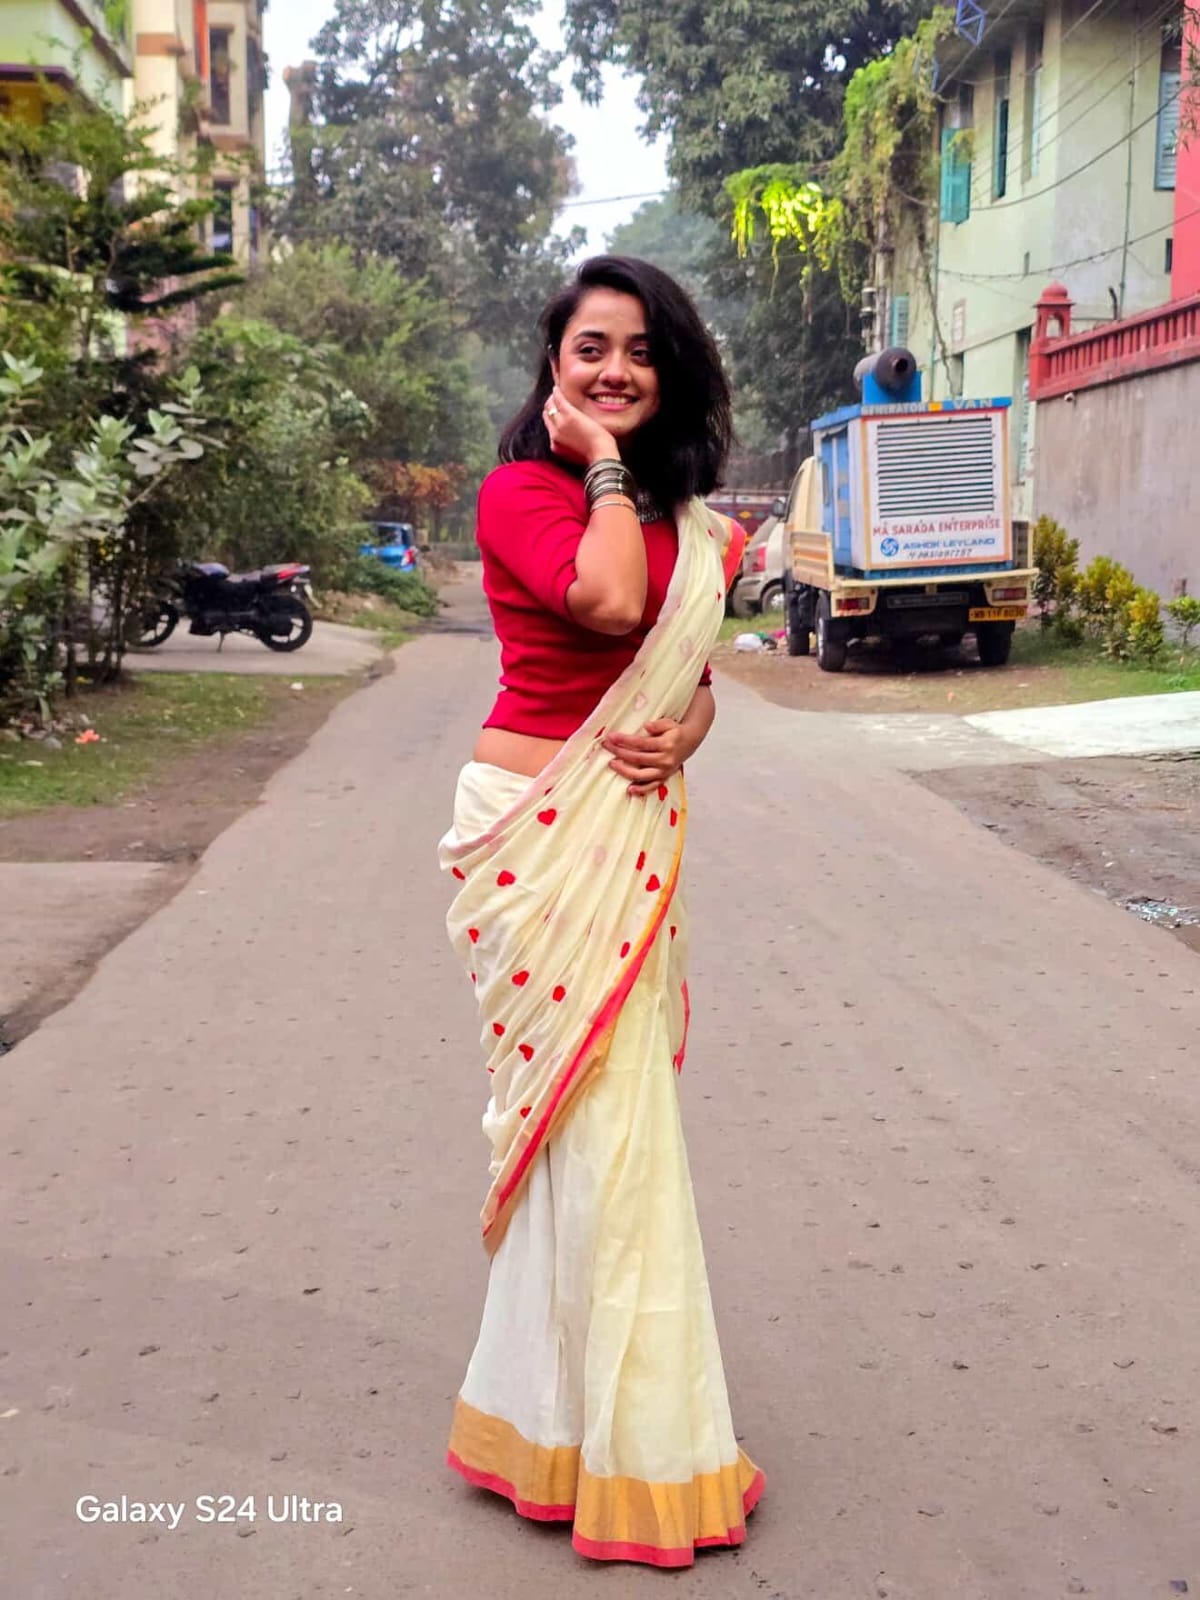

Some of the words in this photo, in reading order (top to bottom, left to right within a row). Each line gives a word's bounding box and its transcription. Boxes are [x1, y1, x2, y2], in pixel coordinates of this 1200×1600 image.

[861, 402, 927, 415] GENERATOR
[953, 398, 993, 410] VAN
[873, 526, 889, 536] MA
[892, 522, 935, 535] SARADA
[939, 518, 1000, 532] ENTERPRISE
[903, 541, 940, 550] ASHOK
[943, 537, 995, 547] LEYLAND
